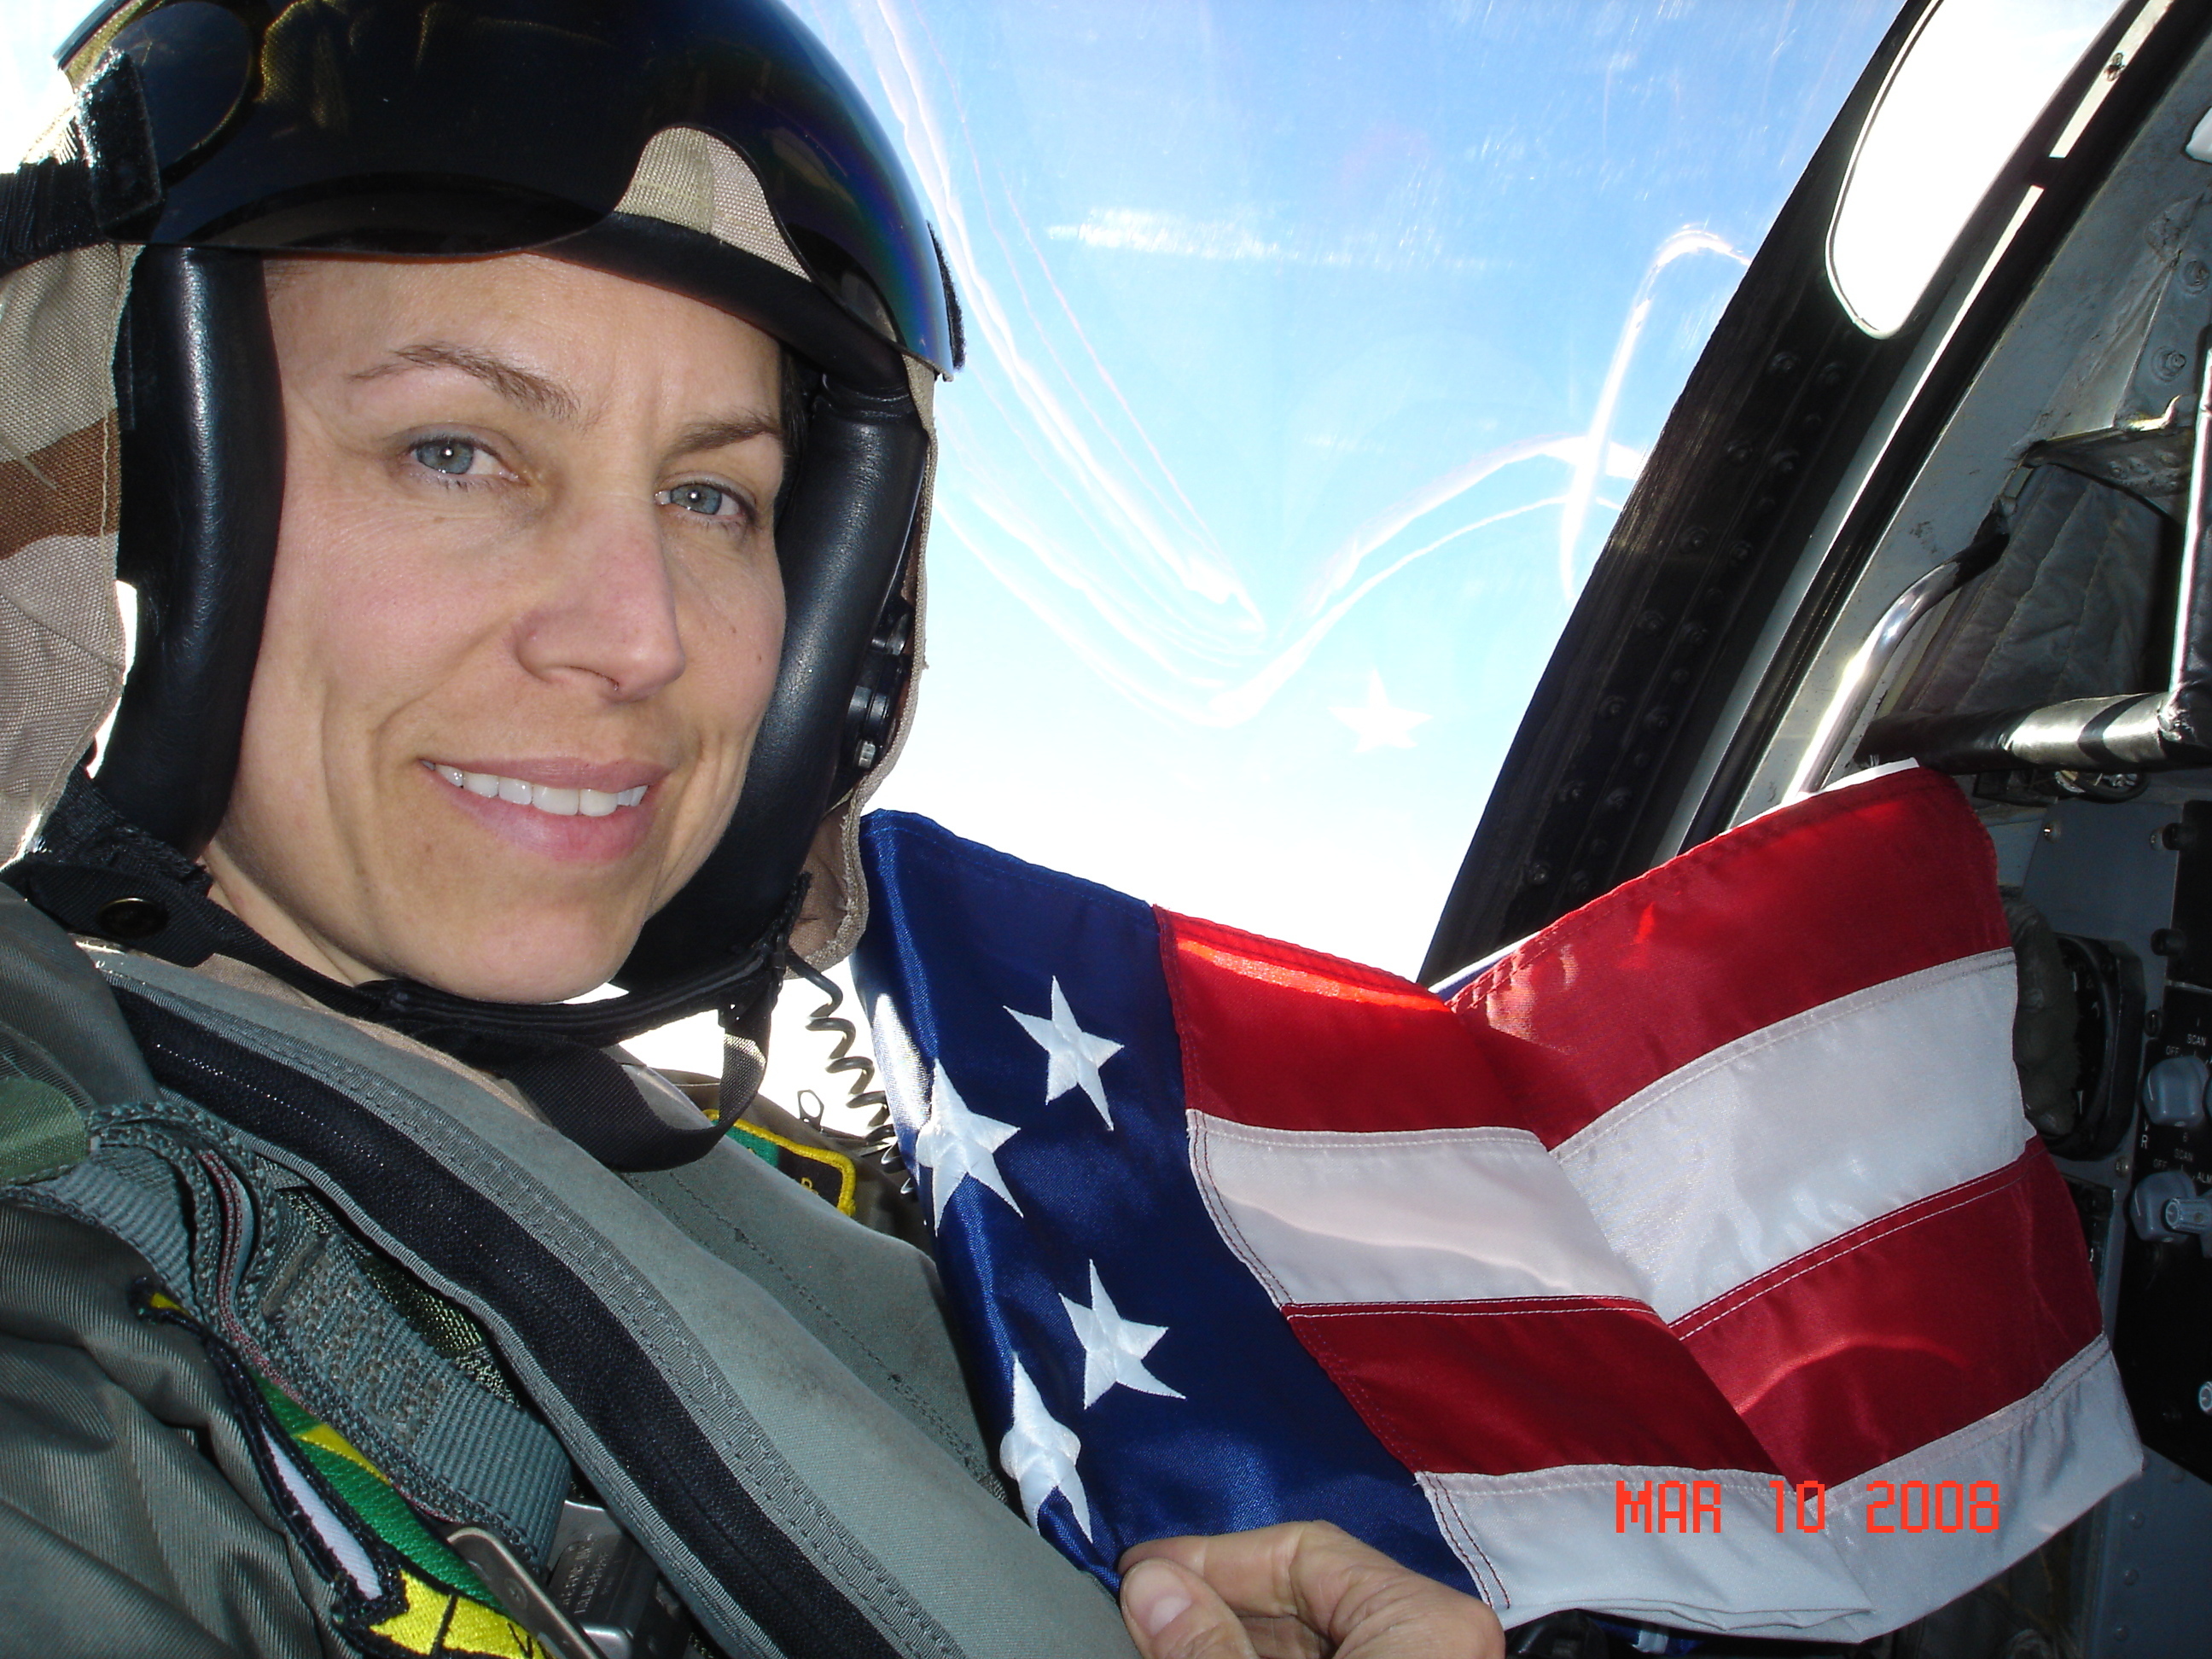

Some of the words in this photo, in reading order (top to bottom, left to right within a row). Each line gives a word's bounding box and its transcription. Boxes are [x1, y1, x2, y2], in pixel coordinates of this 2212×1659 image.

[2187, 1033, 2206, 1047] SCAN
[2165, 1045, 2180, 1056] OFF
[2174, 1148, 2193, 1162] SCAN
[2153, 1158, 2168, 1169] OFF
